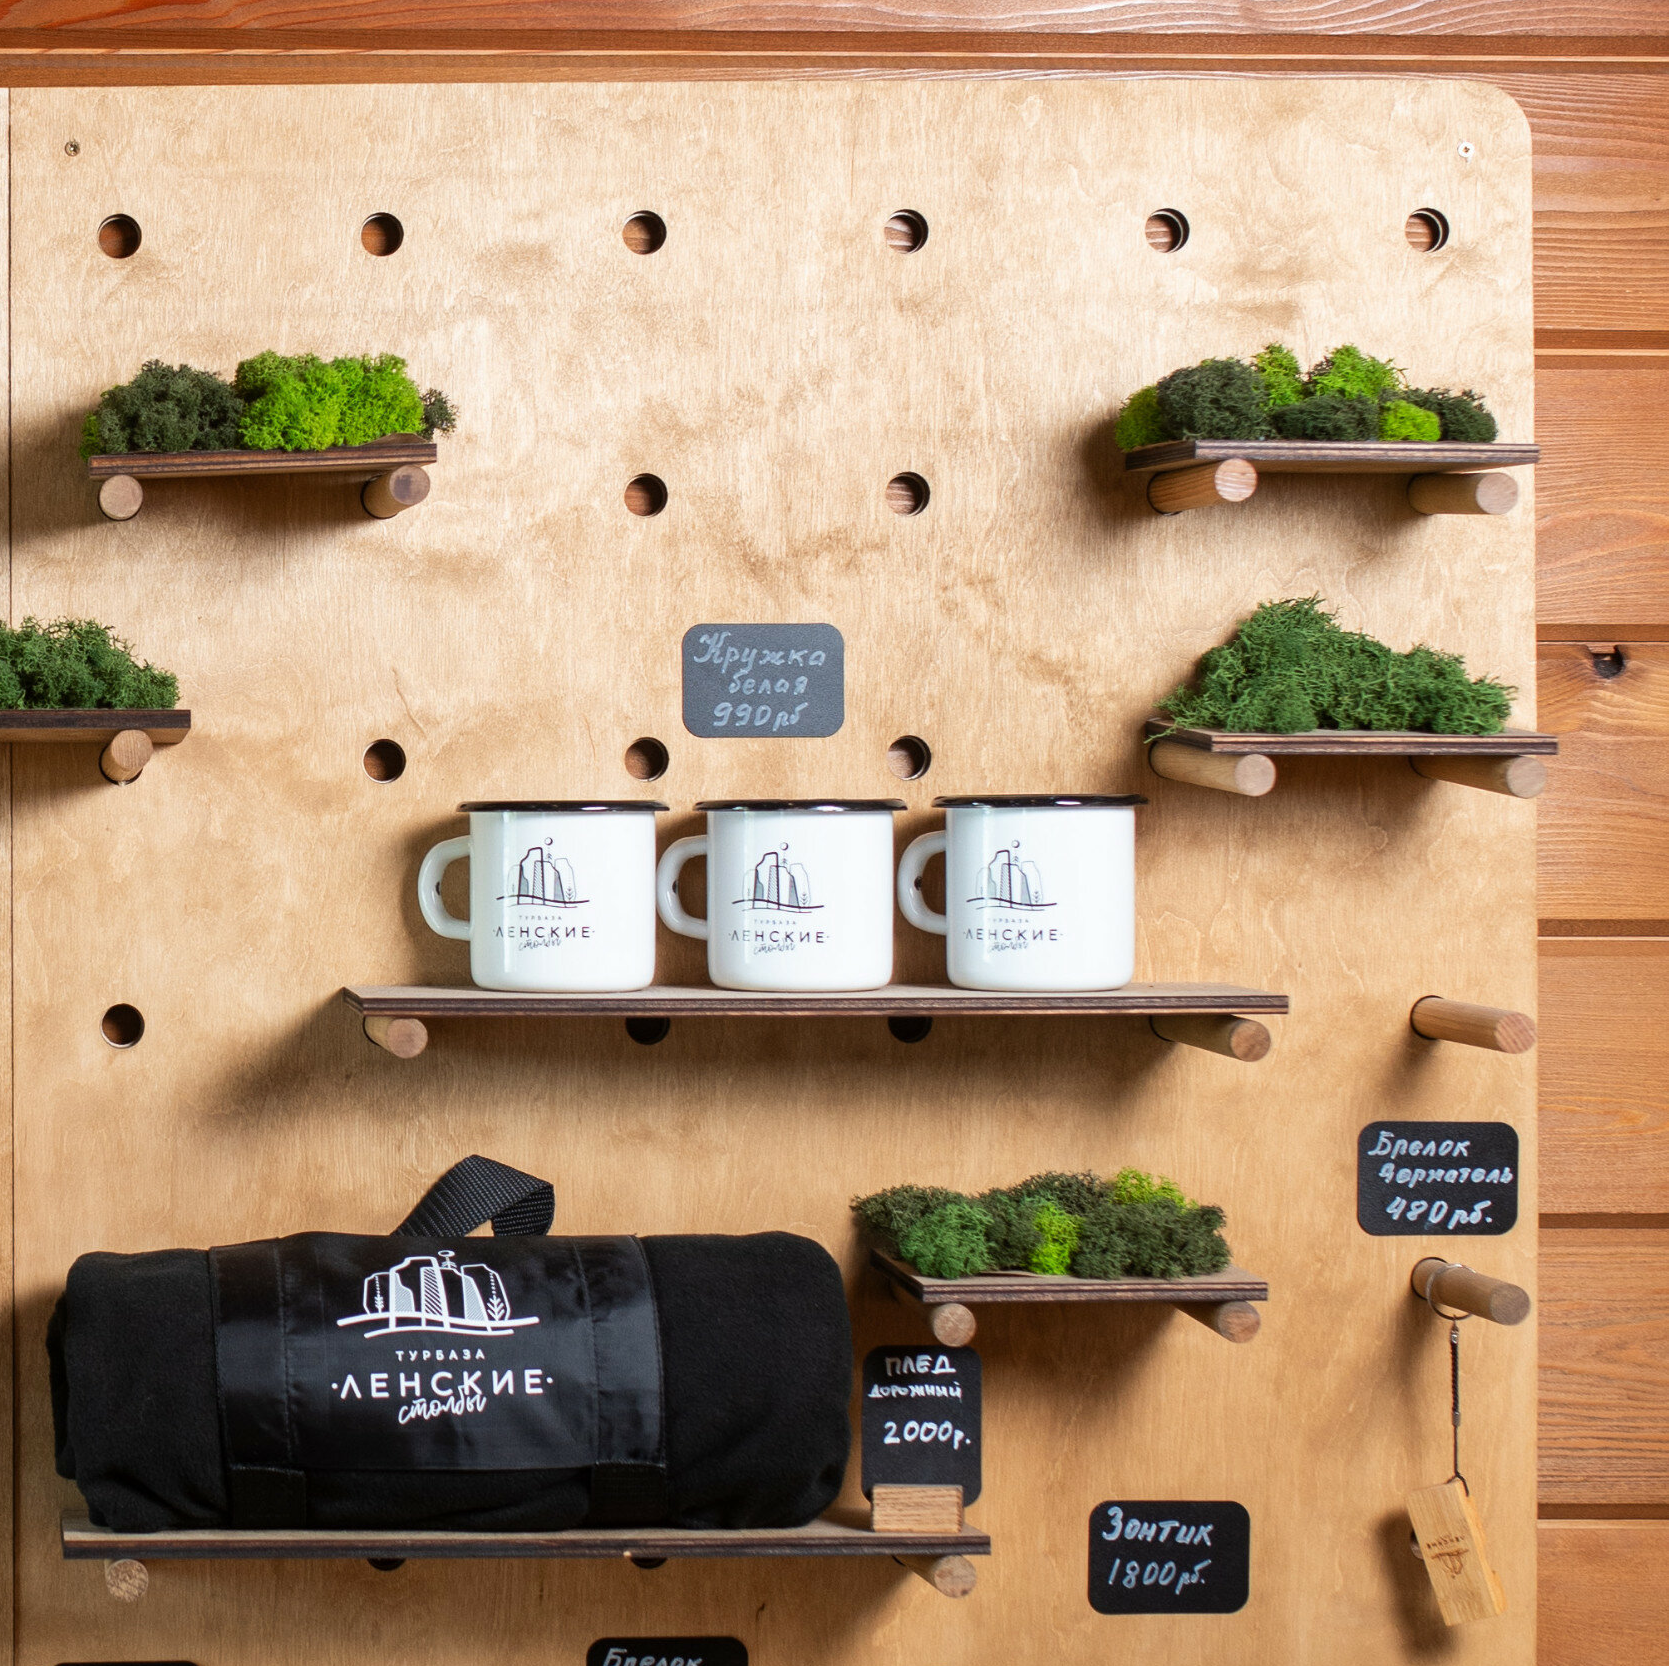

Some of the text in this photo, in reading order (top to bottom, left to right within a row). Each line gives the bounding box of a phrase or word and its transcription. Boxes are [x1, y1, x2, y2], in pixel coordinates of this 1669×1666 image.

[693, 631, 827, 674] Кружка
[728, 668, 809, 696] белая
[496, 926, 590, 939] ЛЕНСКИЕ
[731, 929, 825, 944] ЛЕНСКИЕ
[966, 928, 1058, 941] ЛЕНСКИЕ
[1367, 1130, 1471, 1160] Брелок
[395, 1348, 486, 1362] ТУРБАЗА
[885, 1354, 956, 1377] ПЛЕД
[340, 1368, 544, 1400] ЛЕНСКИЕ
[398, 1384, 487, 1425] столбы
[1102, 1506, 1213, 1547] Зонтик
